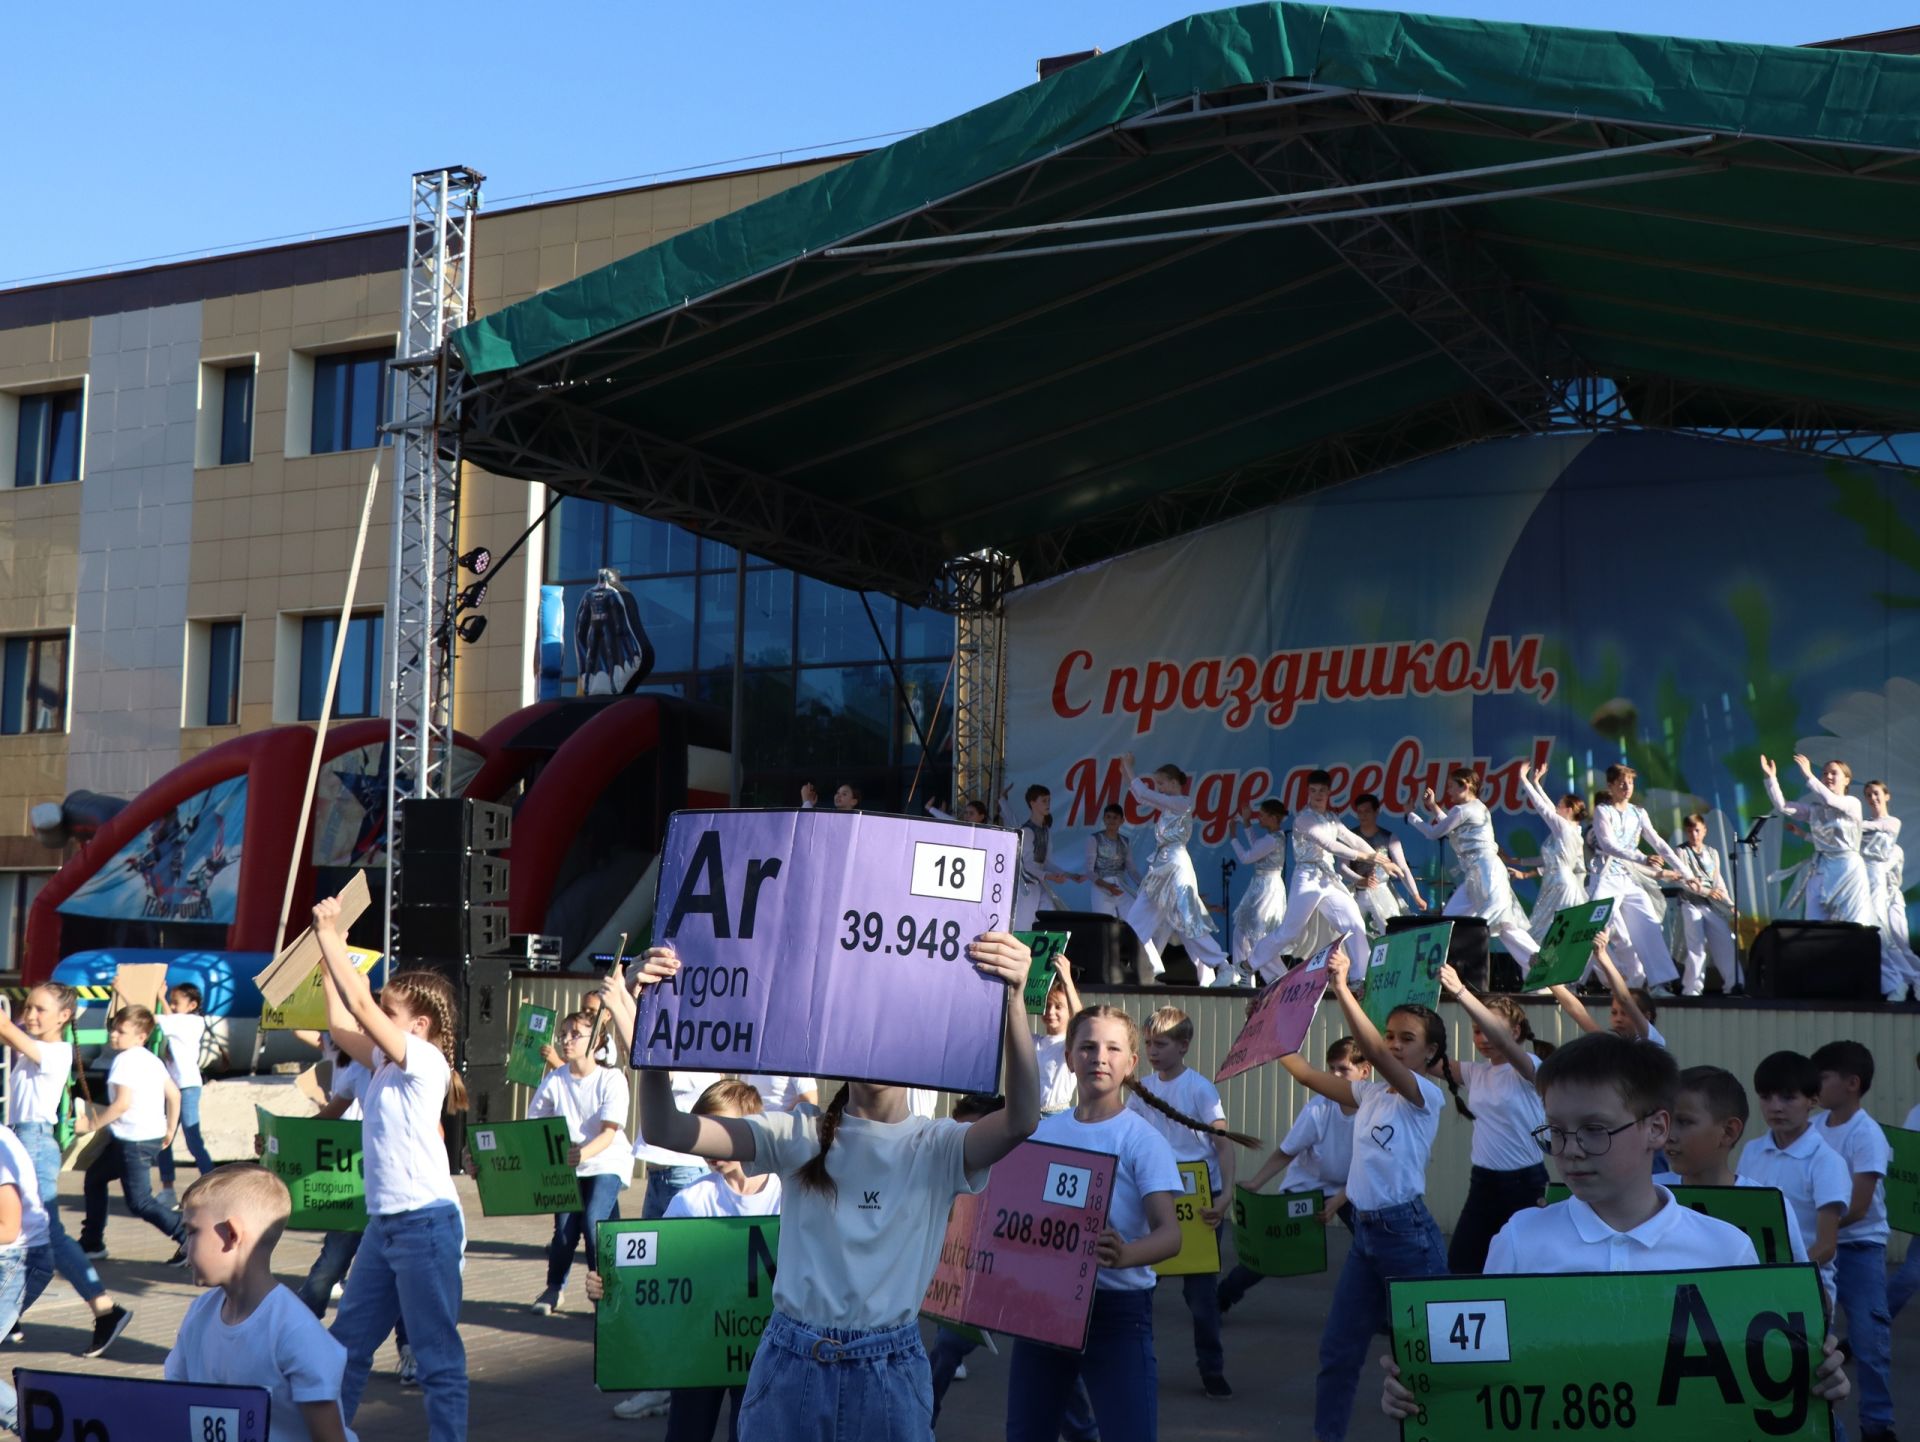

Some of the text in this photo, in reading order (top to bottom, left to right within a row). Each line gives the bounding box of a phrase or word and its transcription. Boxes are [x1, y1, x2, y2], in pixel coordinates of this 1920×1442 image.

[1051, 637, 1558, 734] С праздником,
[934, 855, 966, 889] 18
[994, 853, 1005, 874] 8
[662, 830, 783, 939] Ar
[991, 883, 1002, 904] 8
[988, 912, 1000, 932] 2
[840, 909, 961, 962] 39.948
[1410, 931, 1442, 984] Fe
[654, 964, 749, 1008] Argon
[647, 1008, 754, 1061] Аргон
[480, 1134, 491, 1148] 77
[543, 1124, 566, 1166] Ir
[316, 1138, 353, 1173] Eu
[491, 1156, 521, 1171] 192.22
[303, 1178, 354, 1196] Europium
[1055, 1172, 1078, 1198] 83
[1095, 1172, 1103, 1188] 5
[303, 1195, 354, 1211] Европий
[533, 1190, 578, 1208] Иридий
[1089, 1195, 1102, 1212] 18
[1295, 1202, 1308, 1214] 20
[992, 1208, 1081, 1253] 208.980
[1084, 1217, 1100, 1235] 32
[1265, 1223, 1301, 1239] 40.08
[605, 1234, 613, 1248] 2
[627, 1238, 647, 1260] 28
[1081, 1240, 1096, 1257] 18
[1079, 1262, 1088, 1279] 8
[635, 1277, 692, 1306] 58.70
[1074, 1285, 1084, 1301] 2
[1406, 1303, 1416, 1329] 1
[1449, 1312, 1486, 1351] 47
[1403, 1339, 1427, 1363] 18
[1656, 1283, 1810, 1436] Ag
[1407, 1373, 1431, 1394] 18
[1416, 1403, 1429, 1426] 8
[1476, 1381, 1637, 1430] 107.868
[203, 1415, 227, 1442] 86
[246, 1410, 255, 1429] 8
